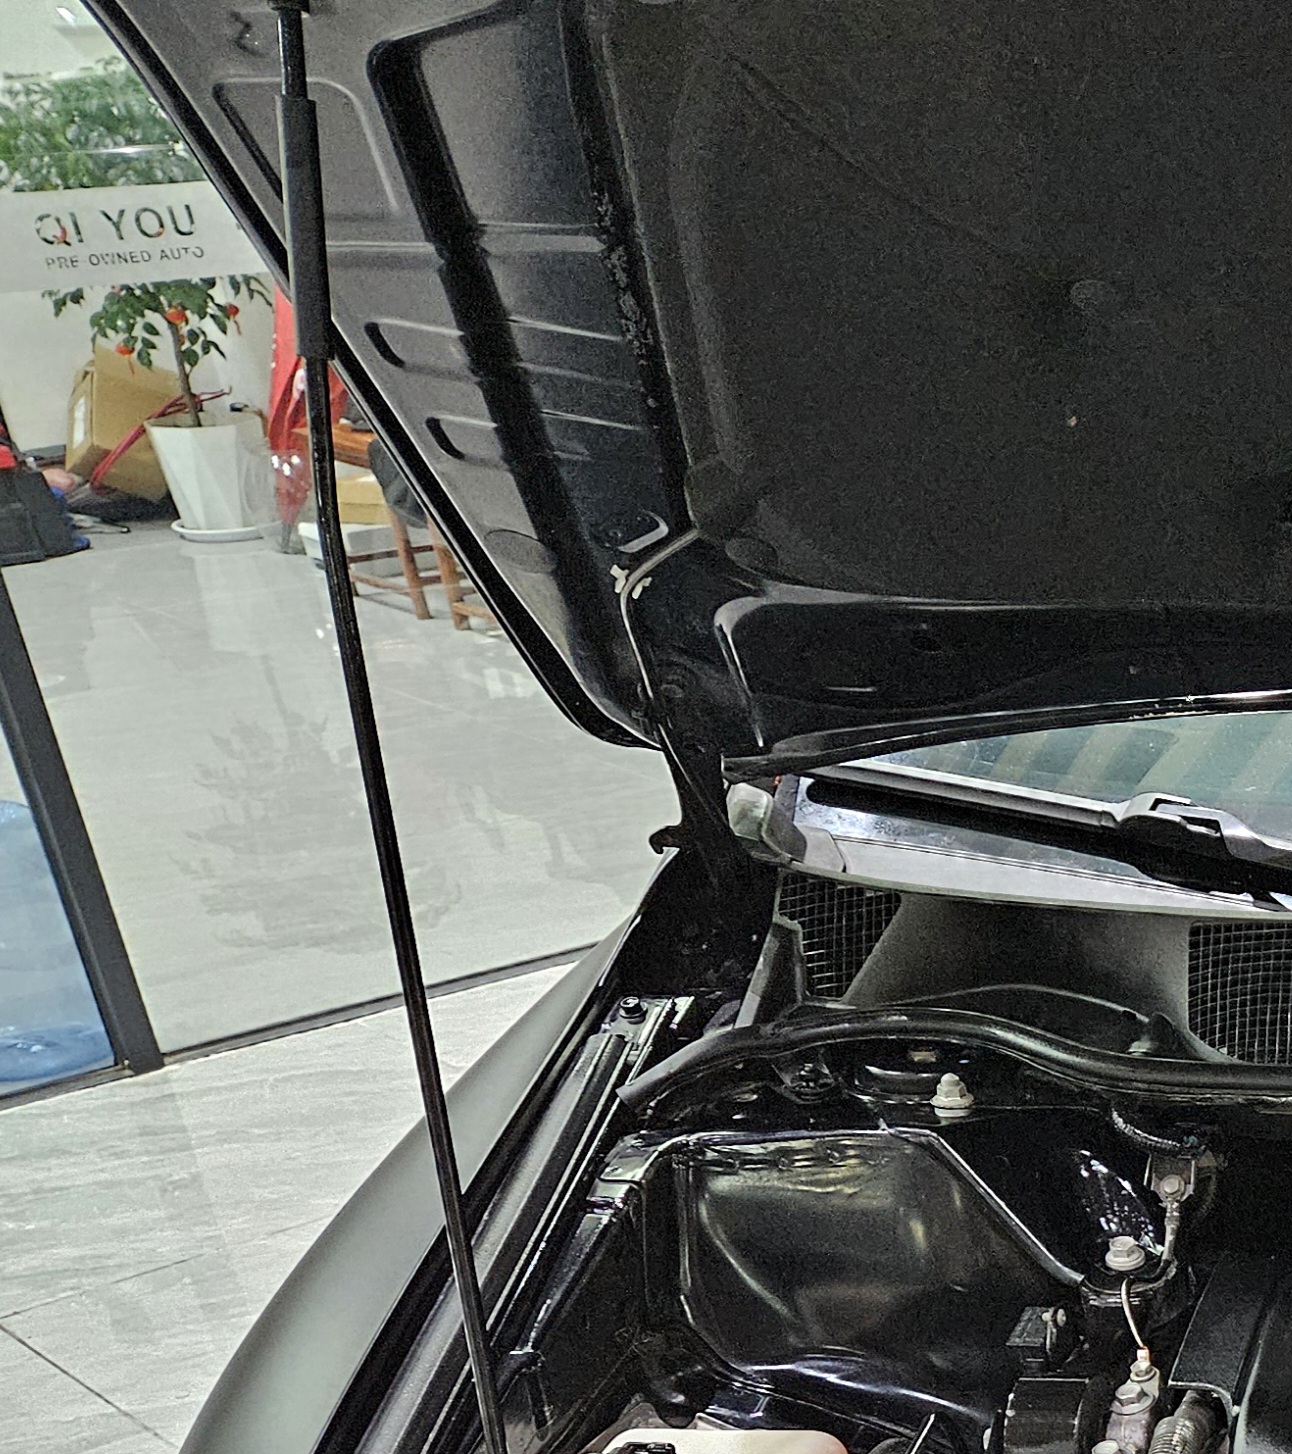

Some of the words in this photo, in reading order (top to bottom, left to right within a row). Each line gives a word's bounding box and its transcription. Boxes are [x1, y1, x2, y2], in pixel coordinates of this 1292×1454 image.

[34, 211, 84, 247] QI
[99, 204, 196, 241] YOU
[160, 246, 205, 261] AUTO
